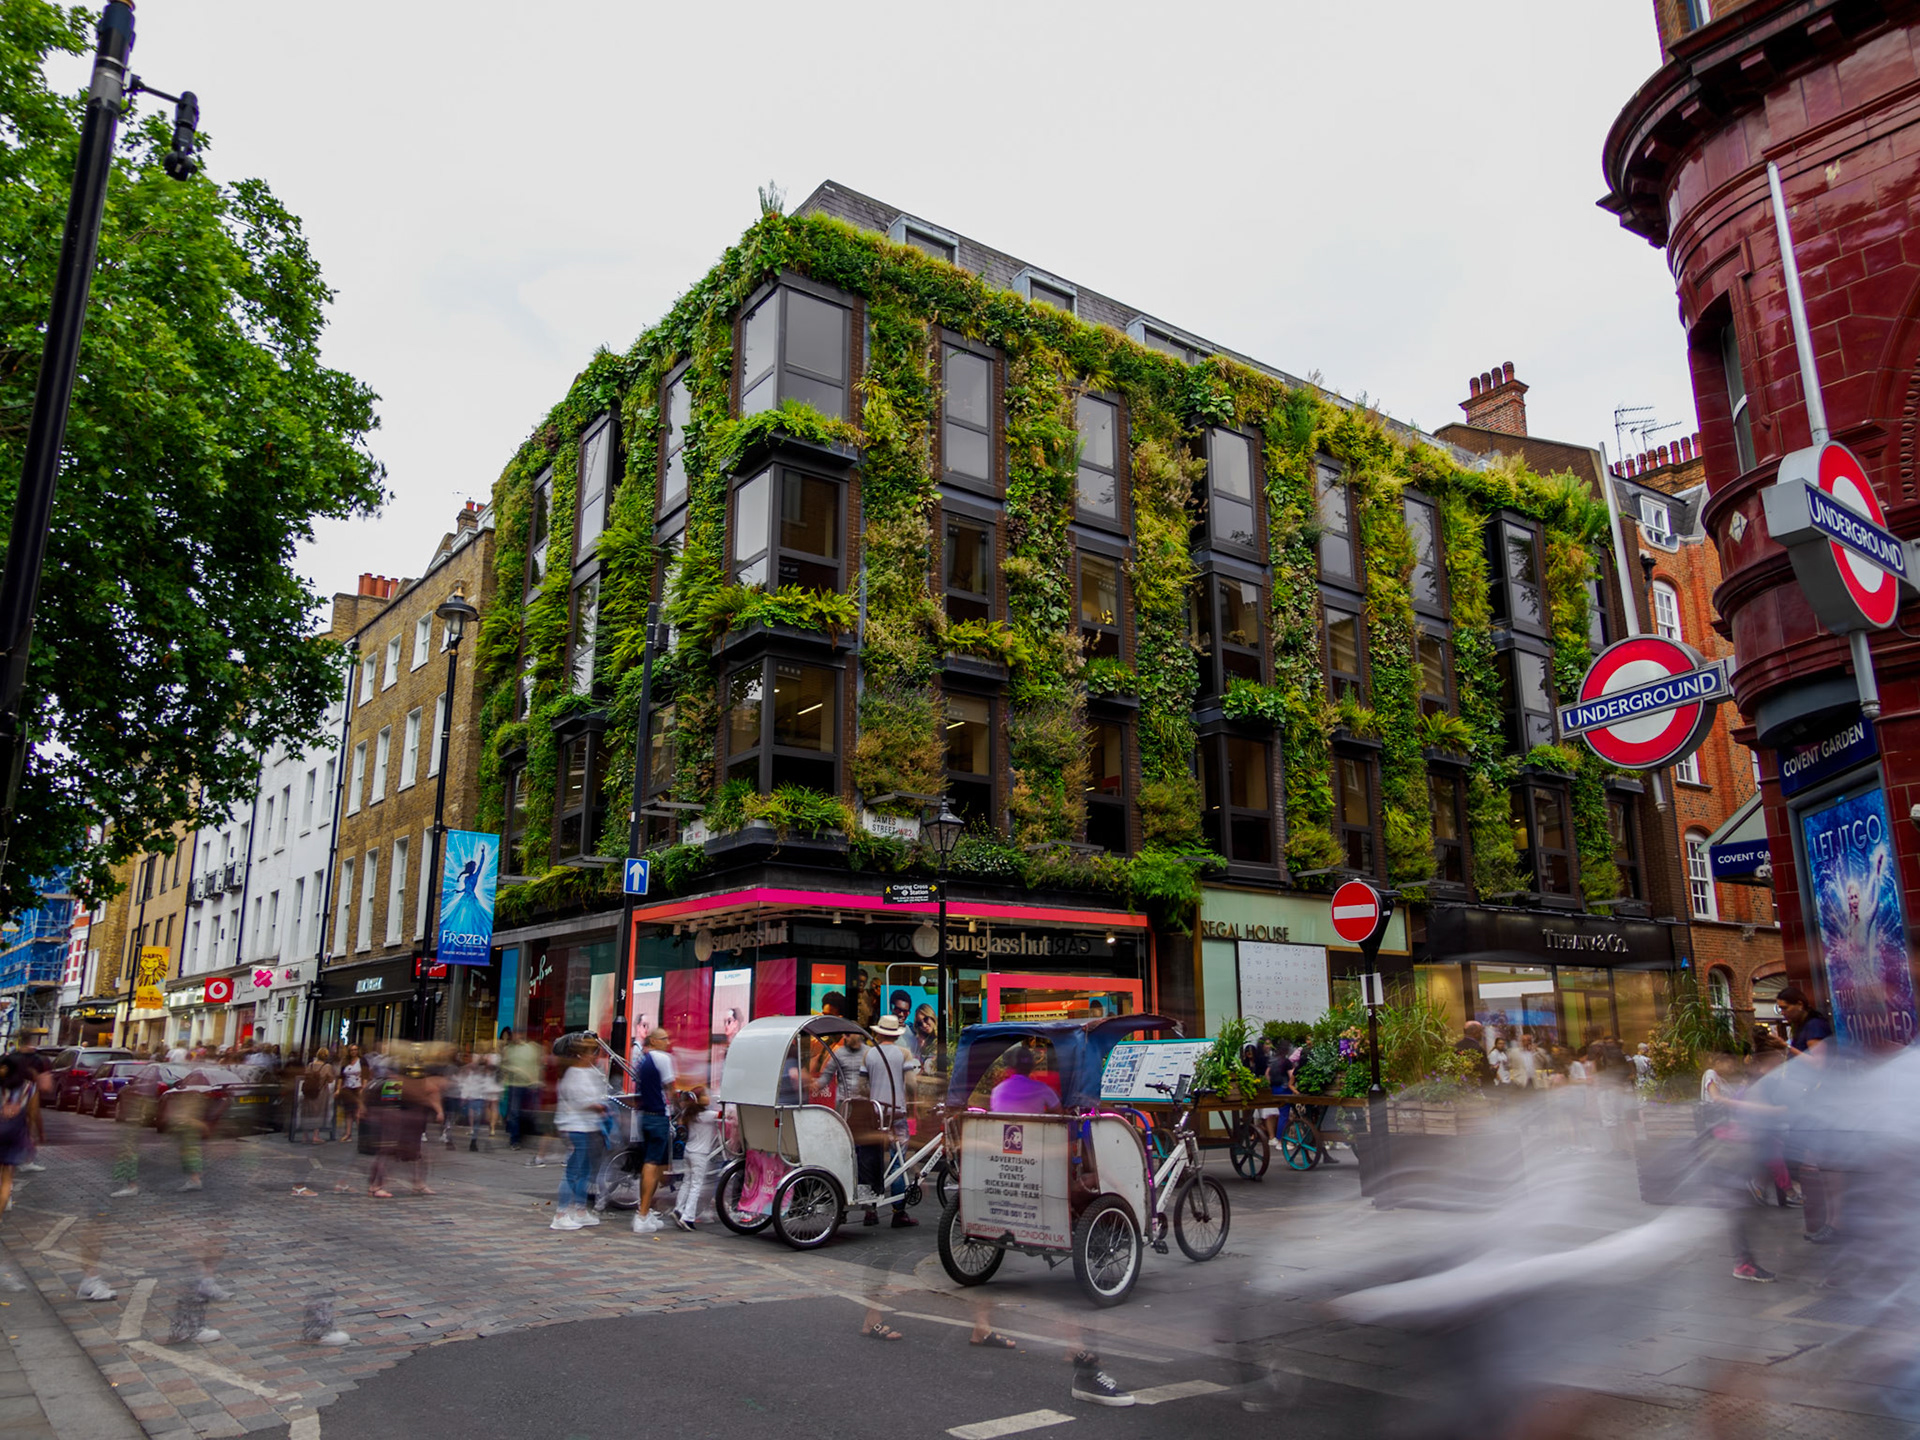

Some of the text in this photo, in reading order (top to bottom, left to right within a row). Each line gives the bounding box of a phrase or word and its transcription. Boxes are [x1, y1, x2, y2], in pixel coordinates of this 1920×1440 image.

[1805, 490, 1904, 572] UNDERGROUND
[1565, 672, 1717, 729] UNDERGROUND
[1783, 722, 1865, 777] COVENT GARDEN
[872, 816, 897, 828] JAMES
[872, 823, 897, 834] STREET
[1812, 814, 1882, 863] LET IT GO
[1718, 852, 1755, 864] COVENT
[442, 929, 489, 948] FROZEN
[1200, 920, 1290, 942] REGAL HOUSE
[985, 1179, 1020, 1189] RICKSHAW
[984, 1187, 1040, 1200] JOIN OUR TEAM
[1017, 1229, 1052, 1241] LONDON
[1053, 1233, 1065, 1243] UK
